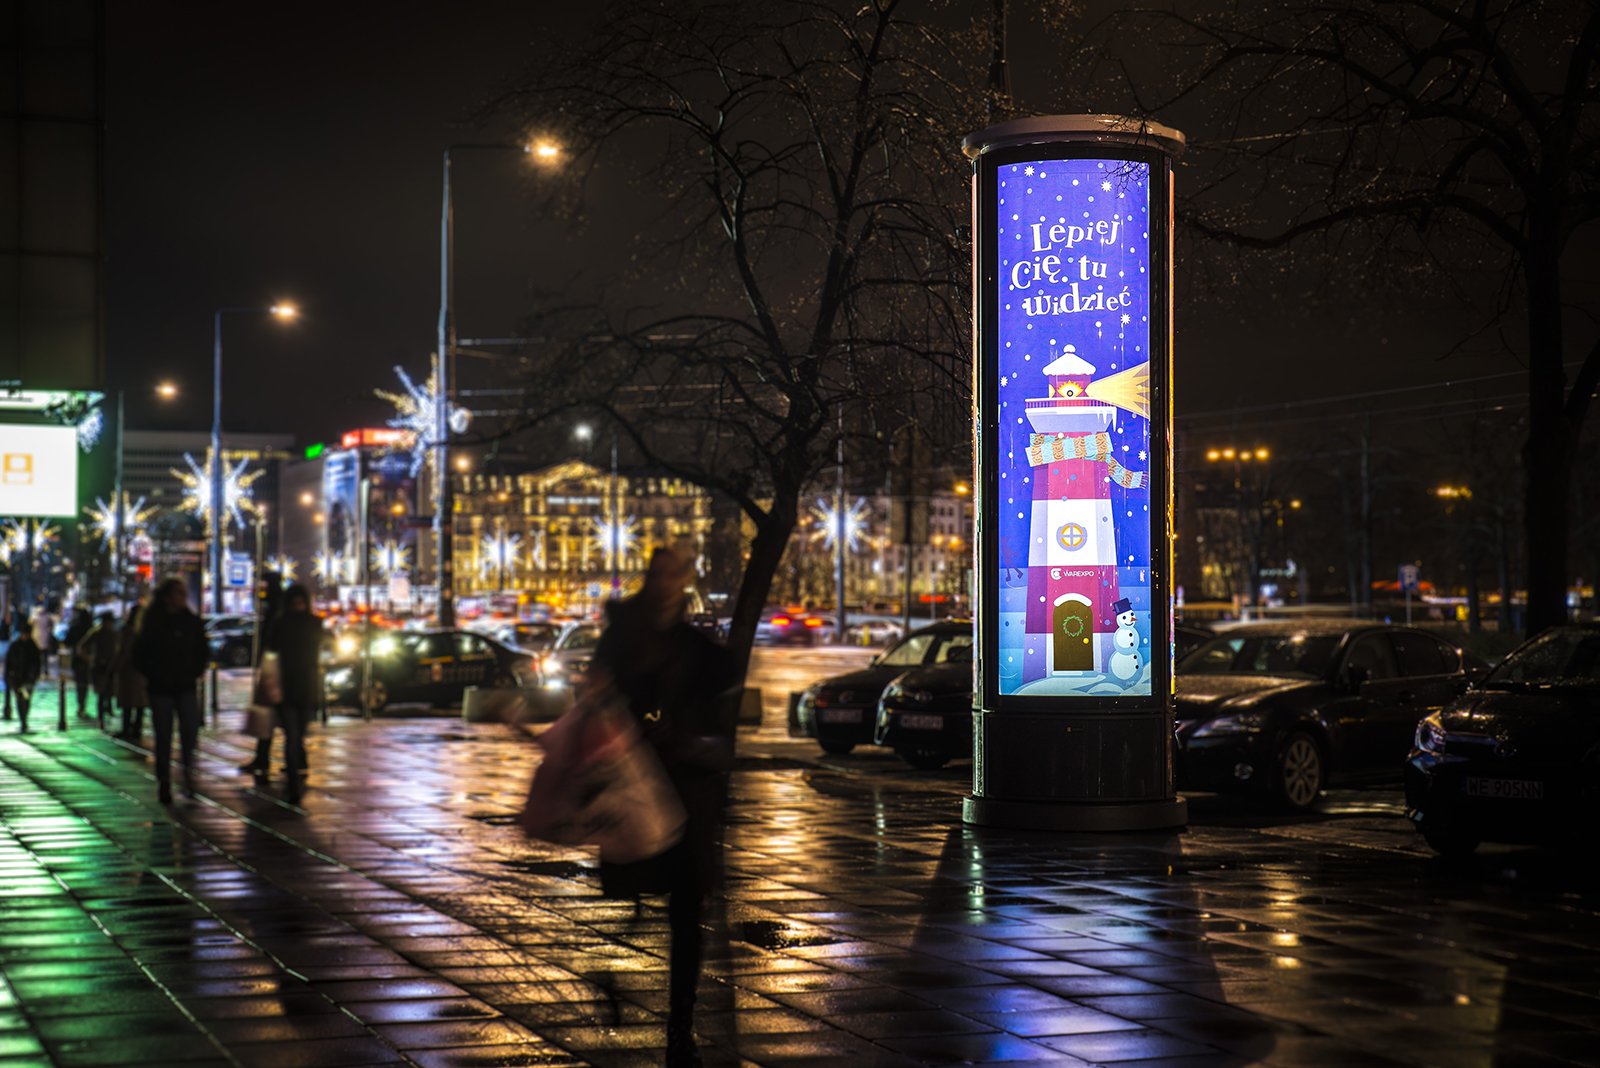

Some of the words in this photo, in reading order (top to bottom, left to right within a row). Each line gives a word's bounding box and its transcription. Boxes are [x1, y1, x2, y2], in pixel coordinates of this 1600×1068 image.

[1029, 218, 1121, 253] Lepiej
[1011, 254, 1062, 290] Cię
[1078, 254, 1108, 281] tu
[1023, 282, 1132, 317] widzieć
[1468, 778, 1489, 795] WE
[1494, 780, 1542, 799] 905NN
